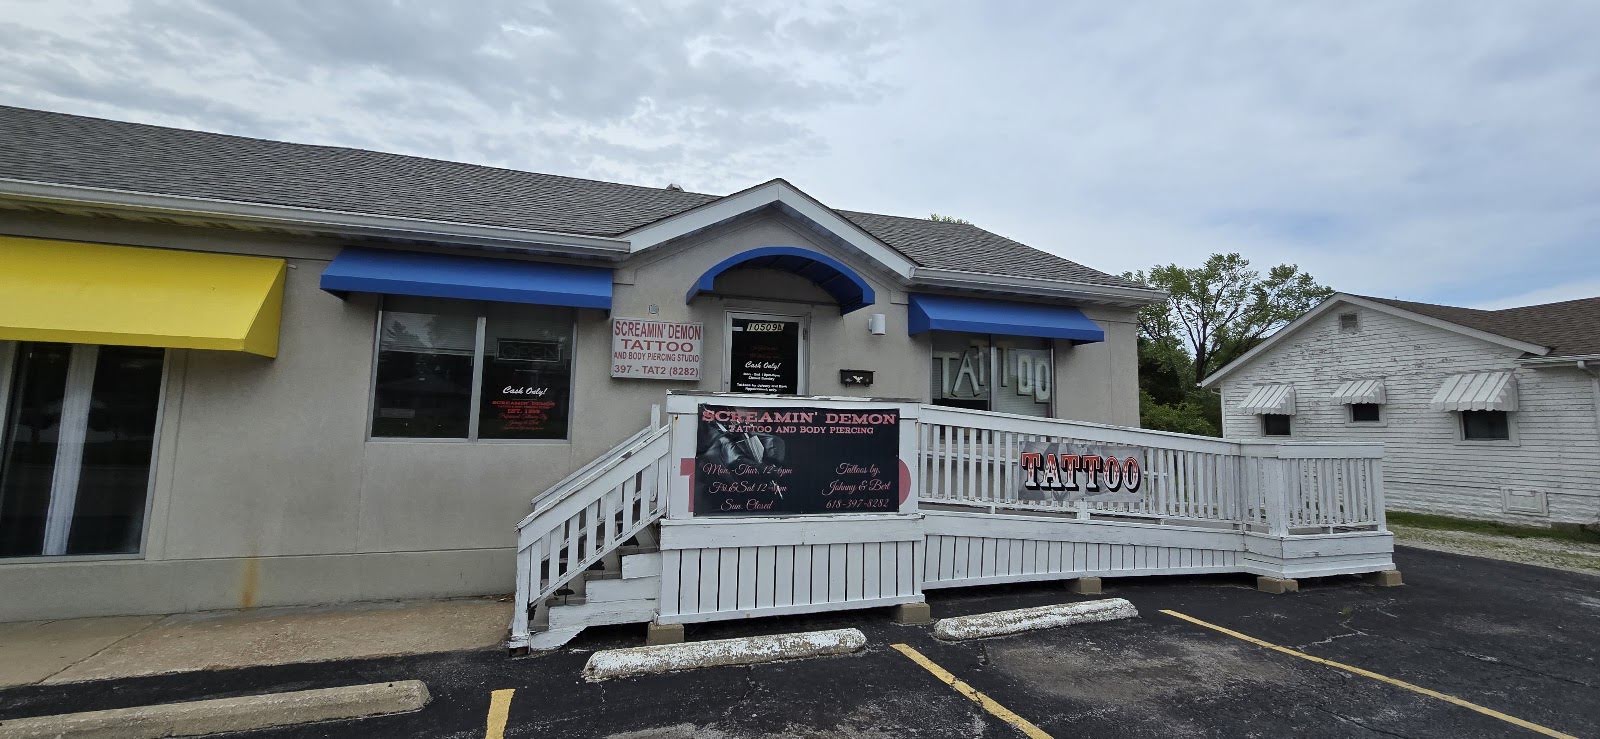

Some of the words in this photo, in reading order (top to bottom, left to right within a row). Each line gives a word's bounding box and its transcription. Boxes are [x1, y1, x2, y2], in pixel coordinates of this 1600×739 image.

[615, 321, 666, 338] SCREAMIN'
[668, 324, 701, 340] DEMON
[621, 339, 694, 353] TATTOO
[614, 351, 627, 360] AND
[628, 352, 647, 361] BODY
[647, 353, 676, 362] PIERCING
[677, 354, 699, 363] STUDIO
[614, 365, 632, 373] 397
[642, 365, 666, 375] TAT2
[669, 366, 698, 377] (8282)
[744, 360, 762, 369] Cash
[763, 361, 782, 371] Only!
[502, 385, 524, 394] Cash
[525, 386, 548, 397] Only!
[702, 410, 818, 423] SCREAMIN'
[825, 413, 896, 425] DEMON
[728, 424, 772, 433] TATTOO
[775, 425, 797, 433] AND
[800, 426, 826, 434] BODY
[829, 426, 874, 434] PIERCING
[836, 462, 868, 475] Tattoos
[1021, 452, 1141, 493] TATTOO
[821, 479, 856, 496] Johnny
[858, 479, 868, 491] &
[868, 478, 891, 491] Bert
[746, 498, 774, 511] Closed
[826, 498, 889, 509] 618-397-8282
